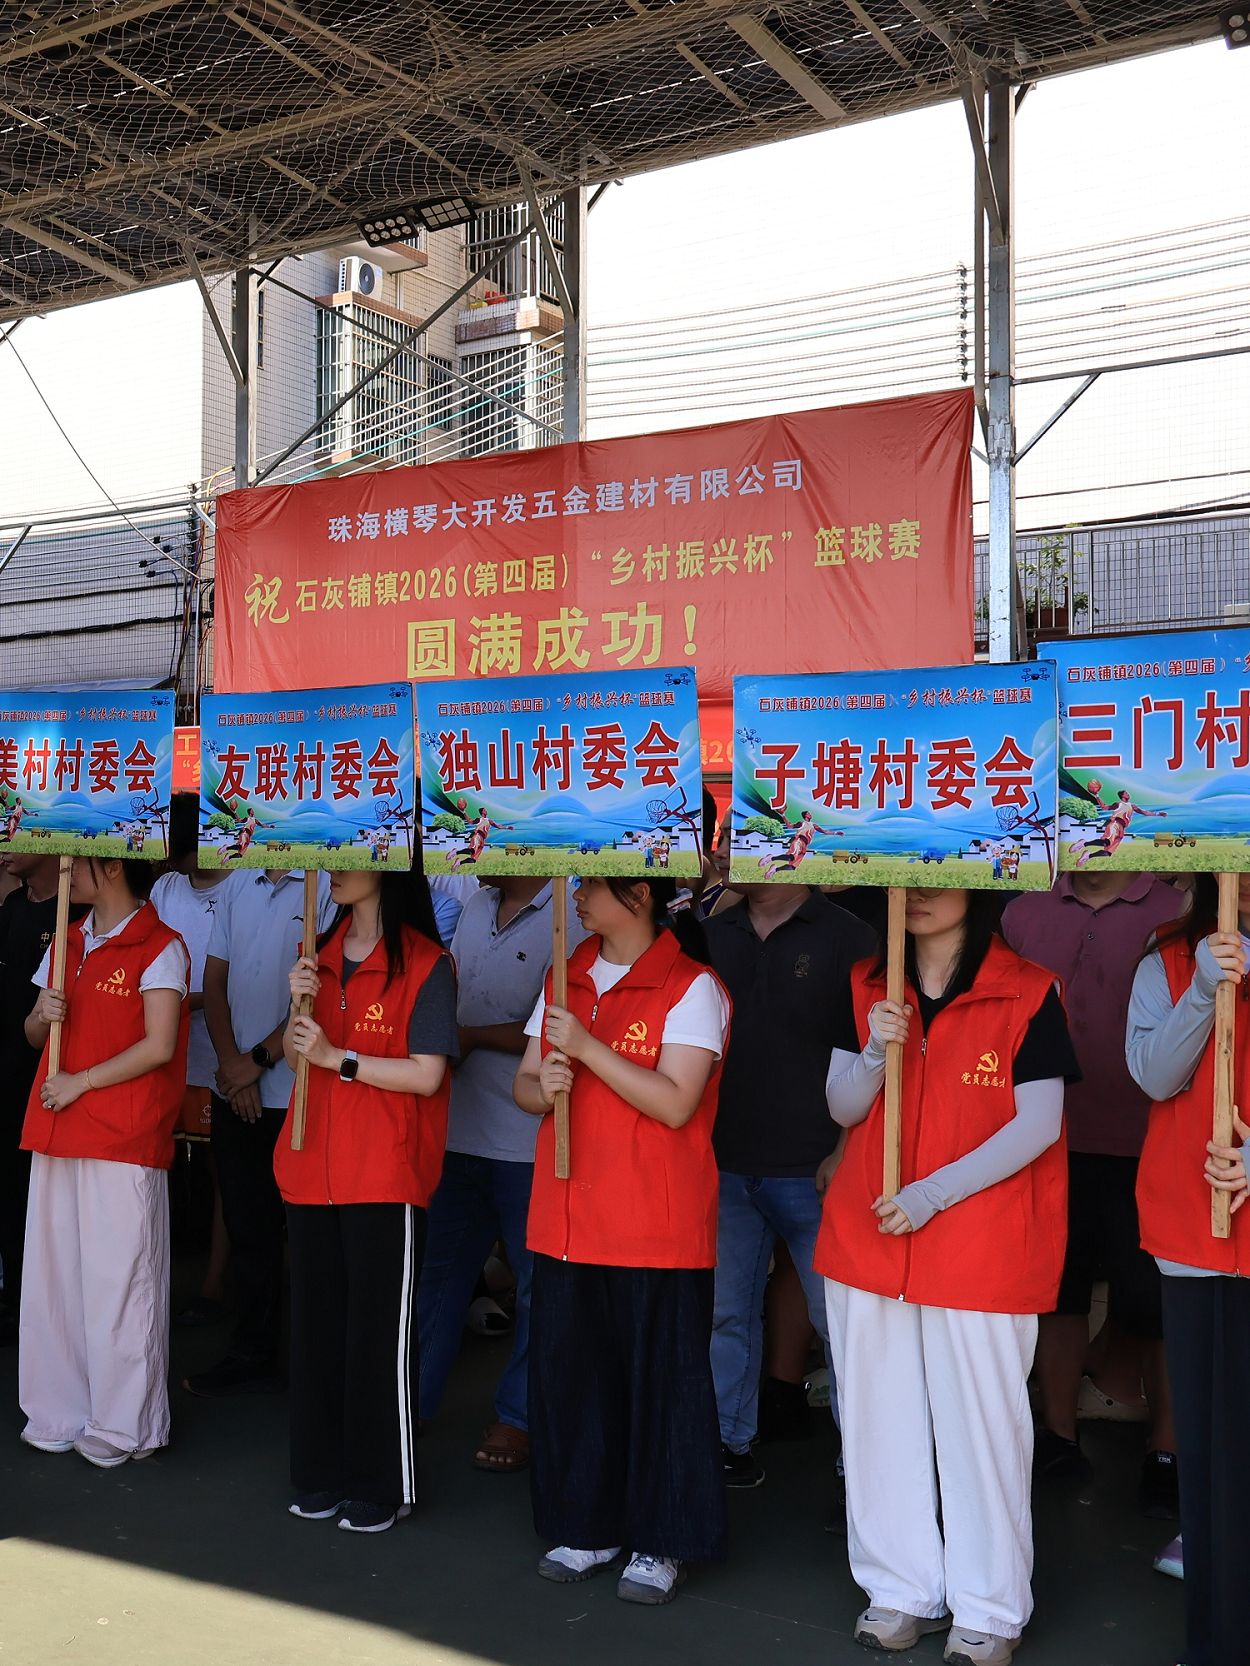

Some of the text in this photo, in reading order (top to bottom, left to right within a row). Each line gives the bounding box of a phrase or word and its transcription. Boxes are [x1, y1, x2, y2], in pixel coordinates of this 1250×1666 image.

[328, 459, 805, 544] 珠海横琴大开发五金建材有限公司
[243, 572, 291, 628] 祝
[406, 603, 698, 680] 圆满成功！
[438, 720, 680, 793] 独山村委会
[1063, 689, 1250, 771] 三门村
[215, 737, 400, 802] 友联村委会
[754, 736, 1035, 811] 子塘村委会
[611, 1040, 658, 1057] 党员志愿者
